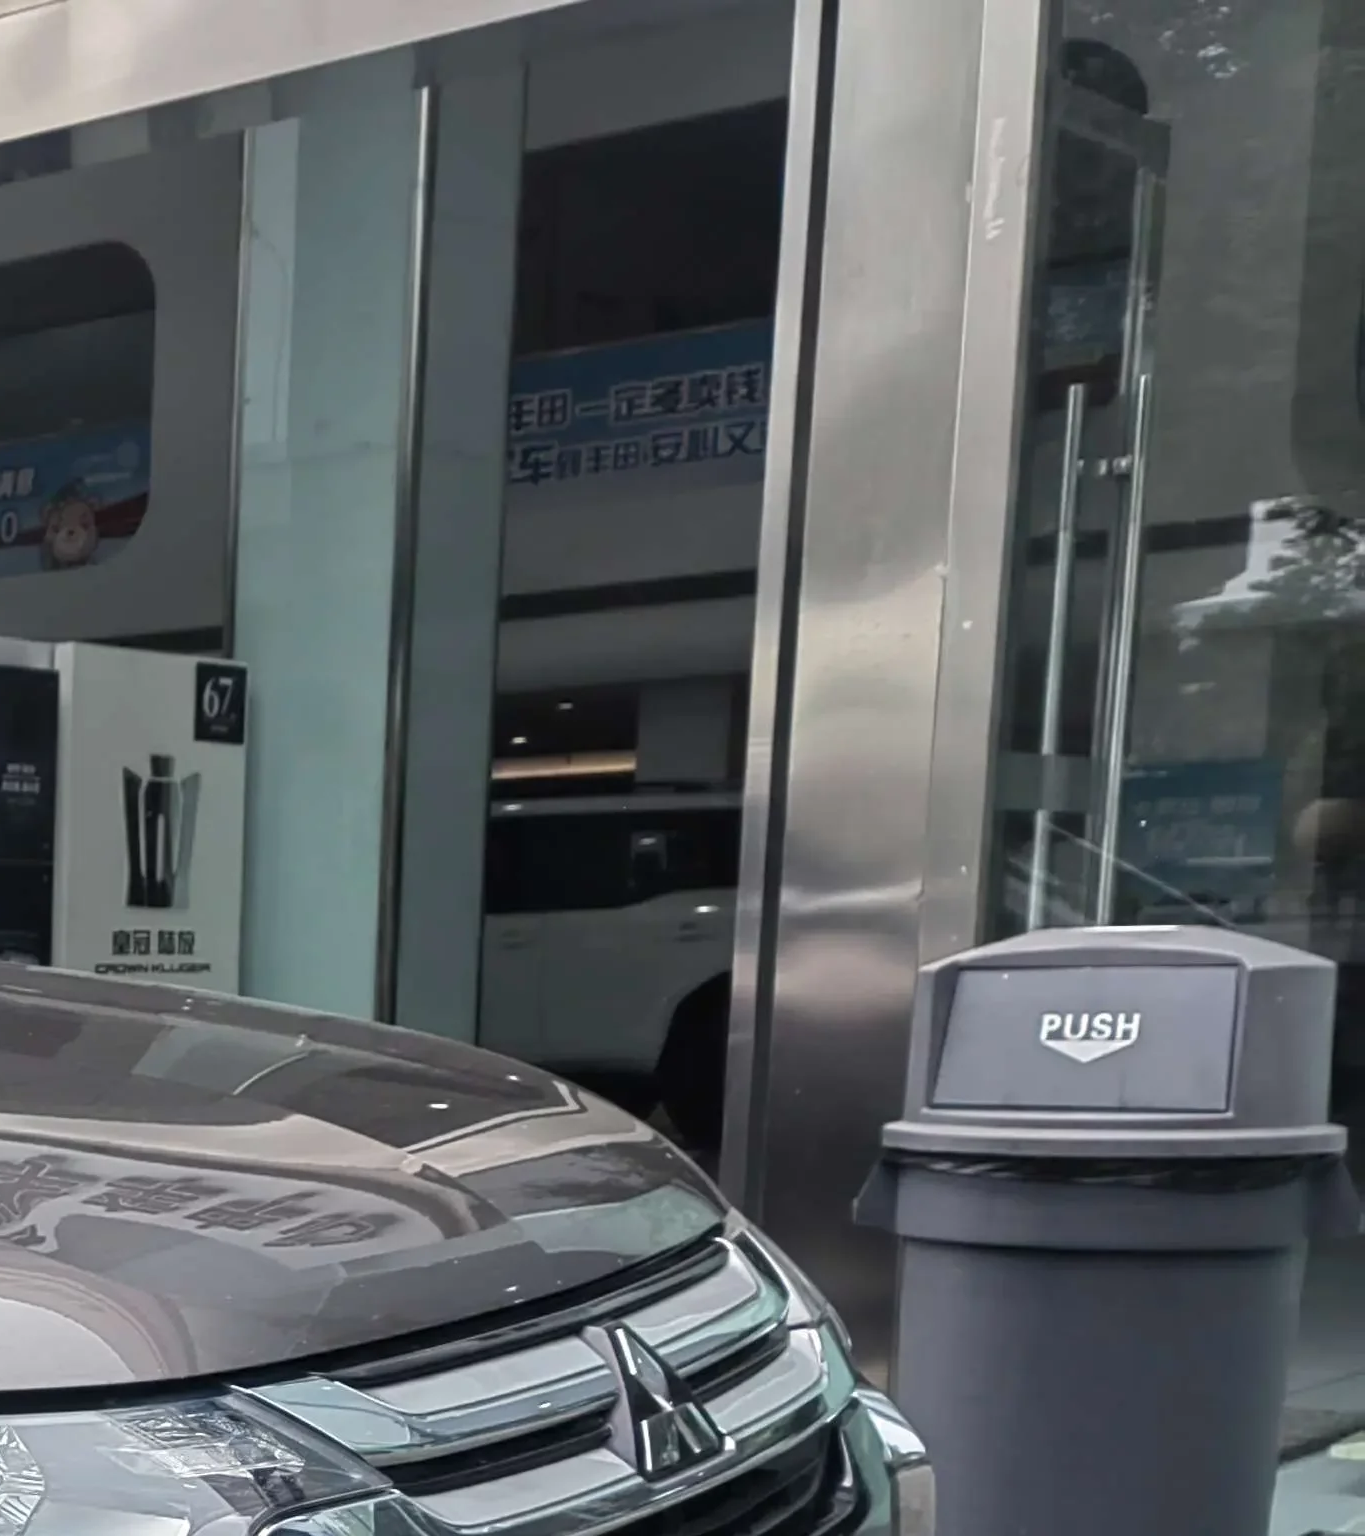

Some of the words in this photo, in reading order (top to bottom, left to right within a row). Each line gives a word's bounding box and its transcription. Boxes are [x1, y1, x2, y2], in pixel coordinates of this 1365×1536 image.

[202, 676, 235, 718] 67
[94, 962, 149, 975] CROWN
[1039, 1012, 1142, 1041] PUSH
